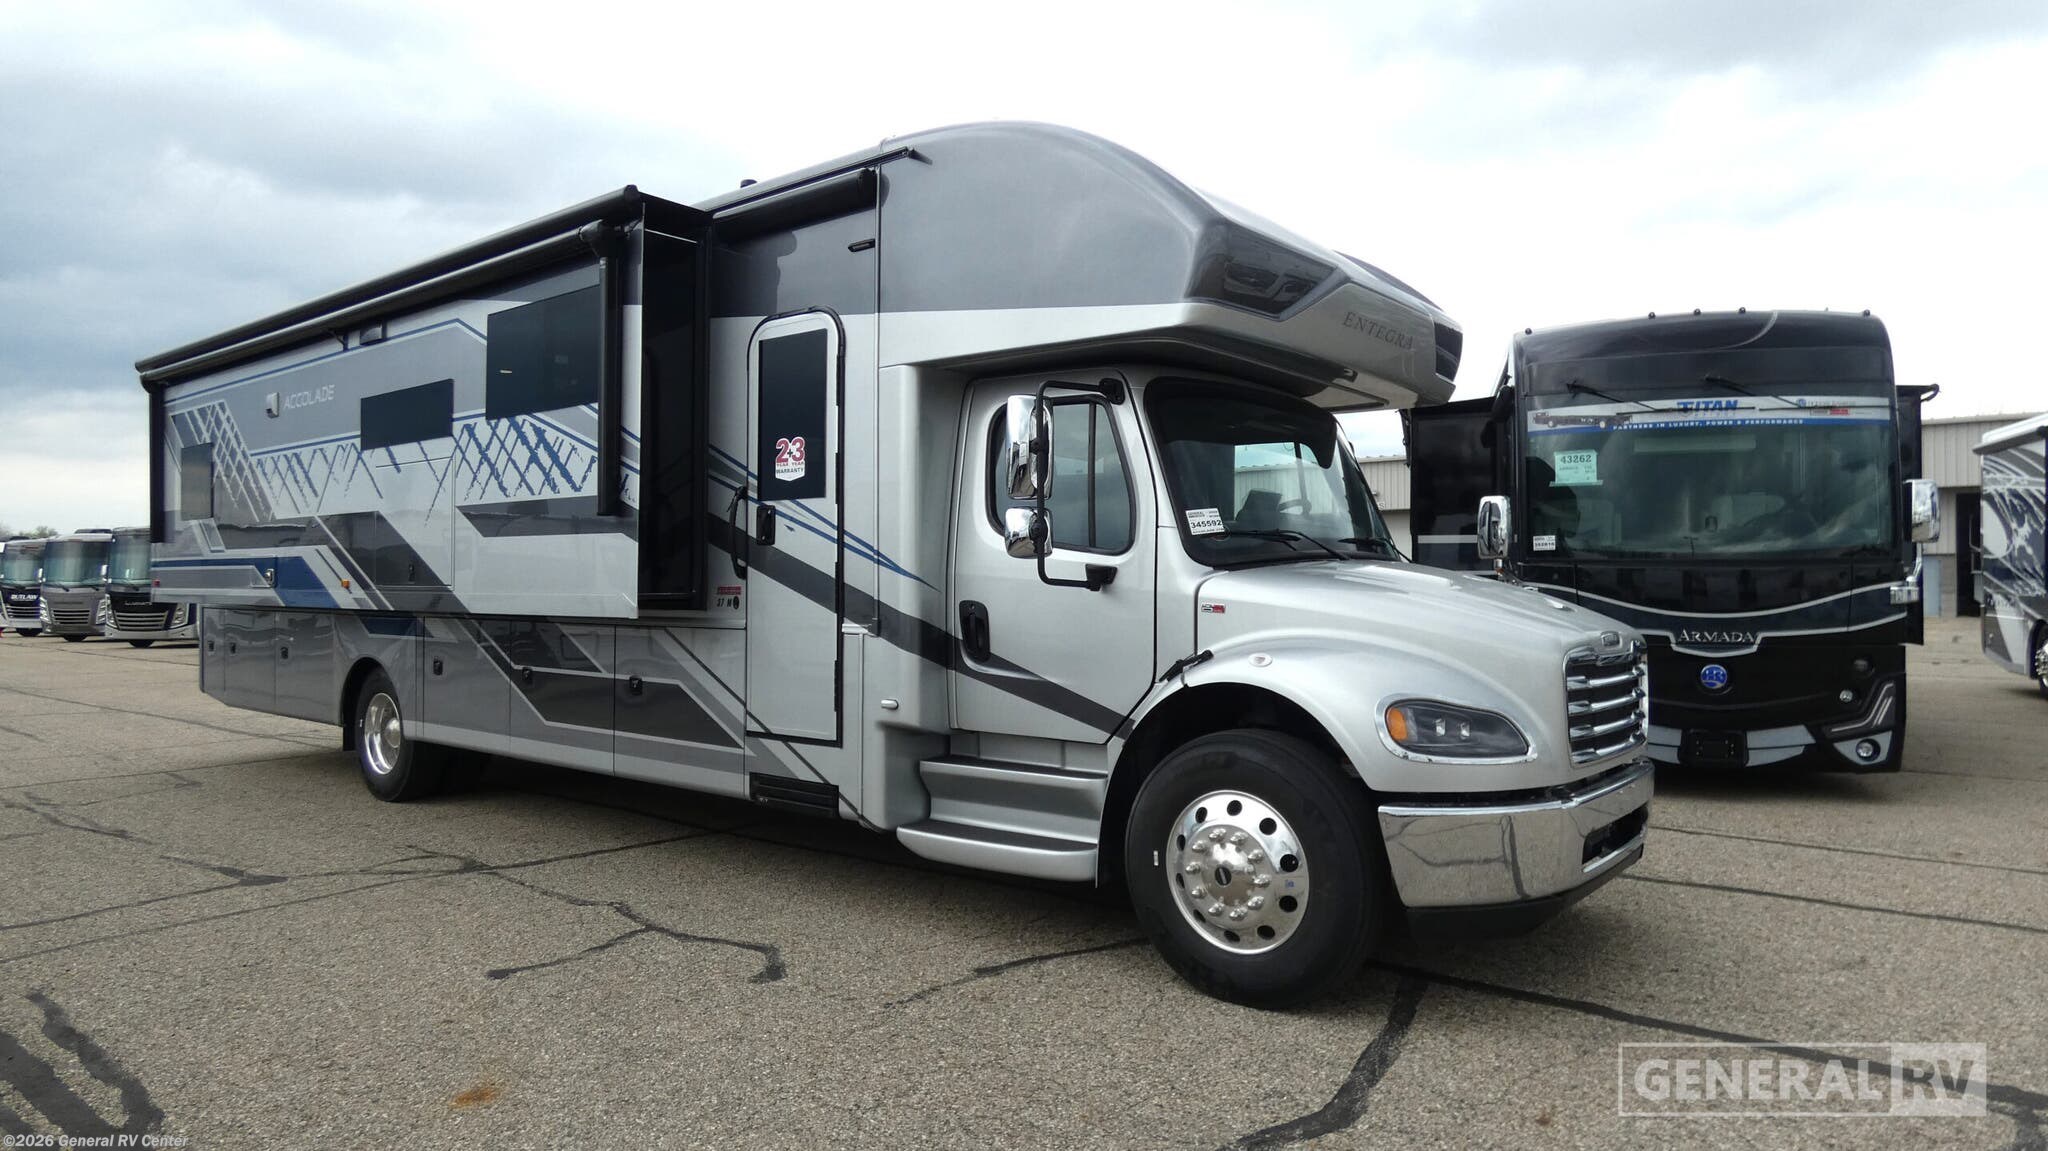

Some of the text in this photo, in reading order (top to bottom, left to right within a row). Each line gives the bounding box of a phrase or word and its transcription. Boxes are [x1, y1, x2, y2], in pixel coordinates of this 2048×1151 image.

[1341, 311, 1413, 350] ENTEGRA
[283, 384, 335, 410] ACCOLADE
[1677, 400, 1738, 411] TITAN
[1613, 423, 1653, 431] PARTNERS
[1745, 418, 1804, 426] PERFORMANCE
[1560, 454, 1592, 464] 43262
[1190, 519, 1223, 529] 345592
[1679, 629, 1756, 643] ARMADA
